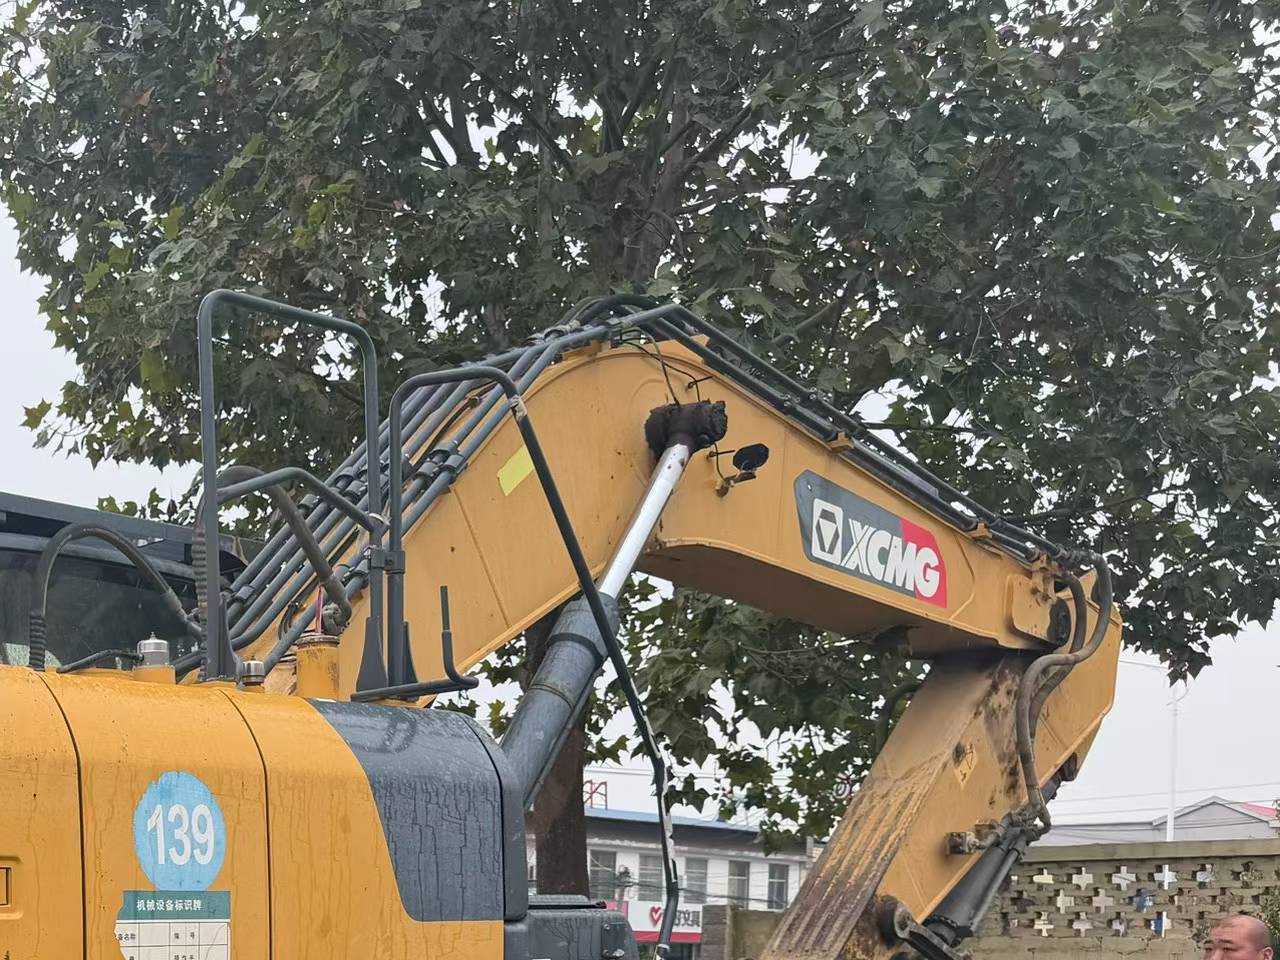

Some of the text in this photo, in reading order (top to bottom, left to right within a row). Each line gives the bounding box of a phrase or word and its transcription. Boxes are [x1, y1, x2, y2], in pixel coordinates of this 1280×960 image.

[841, 519, 940, 597] XCMG
[147, 803, 215, 865] 139
[136, 899, 202, 911] 机械设备标识牌
